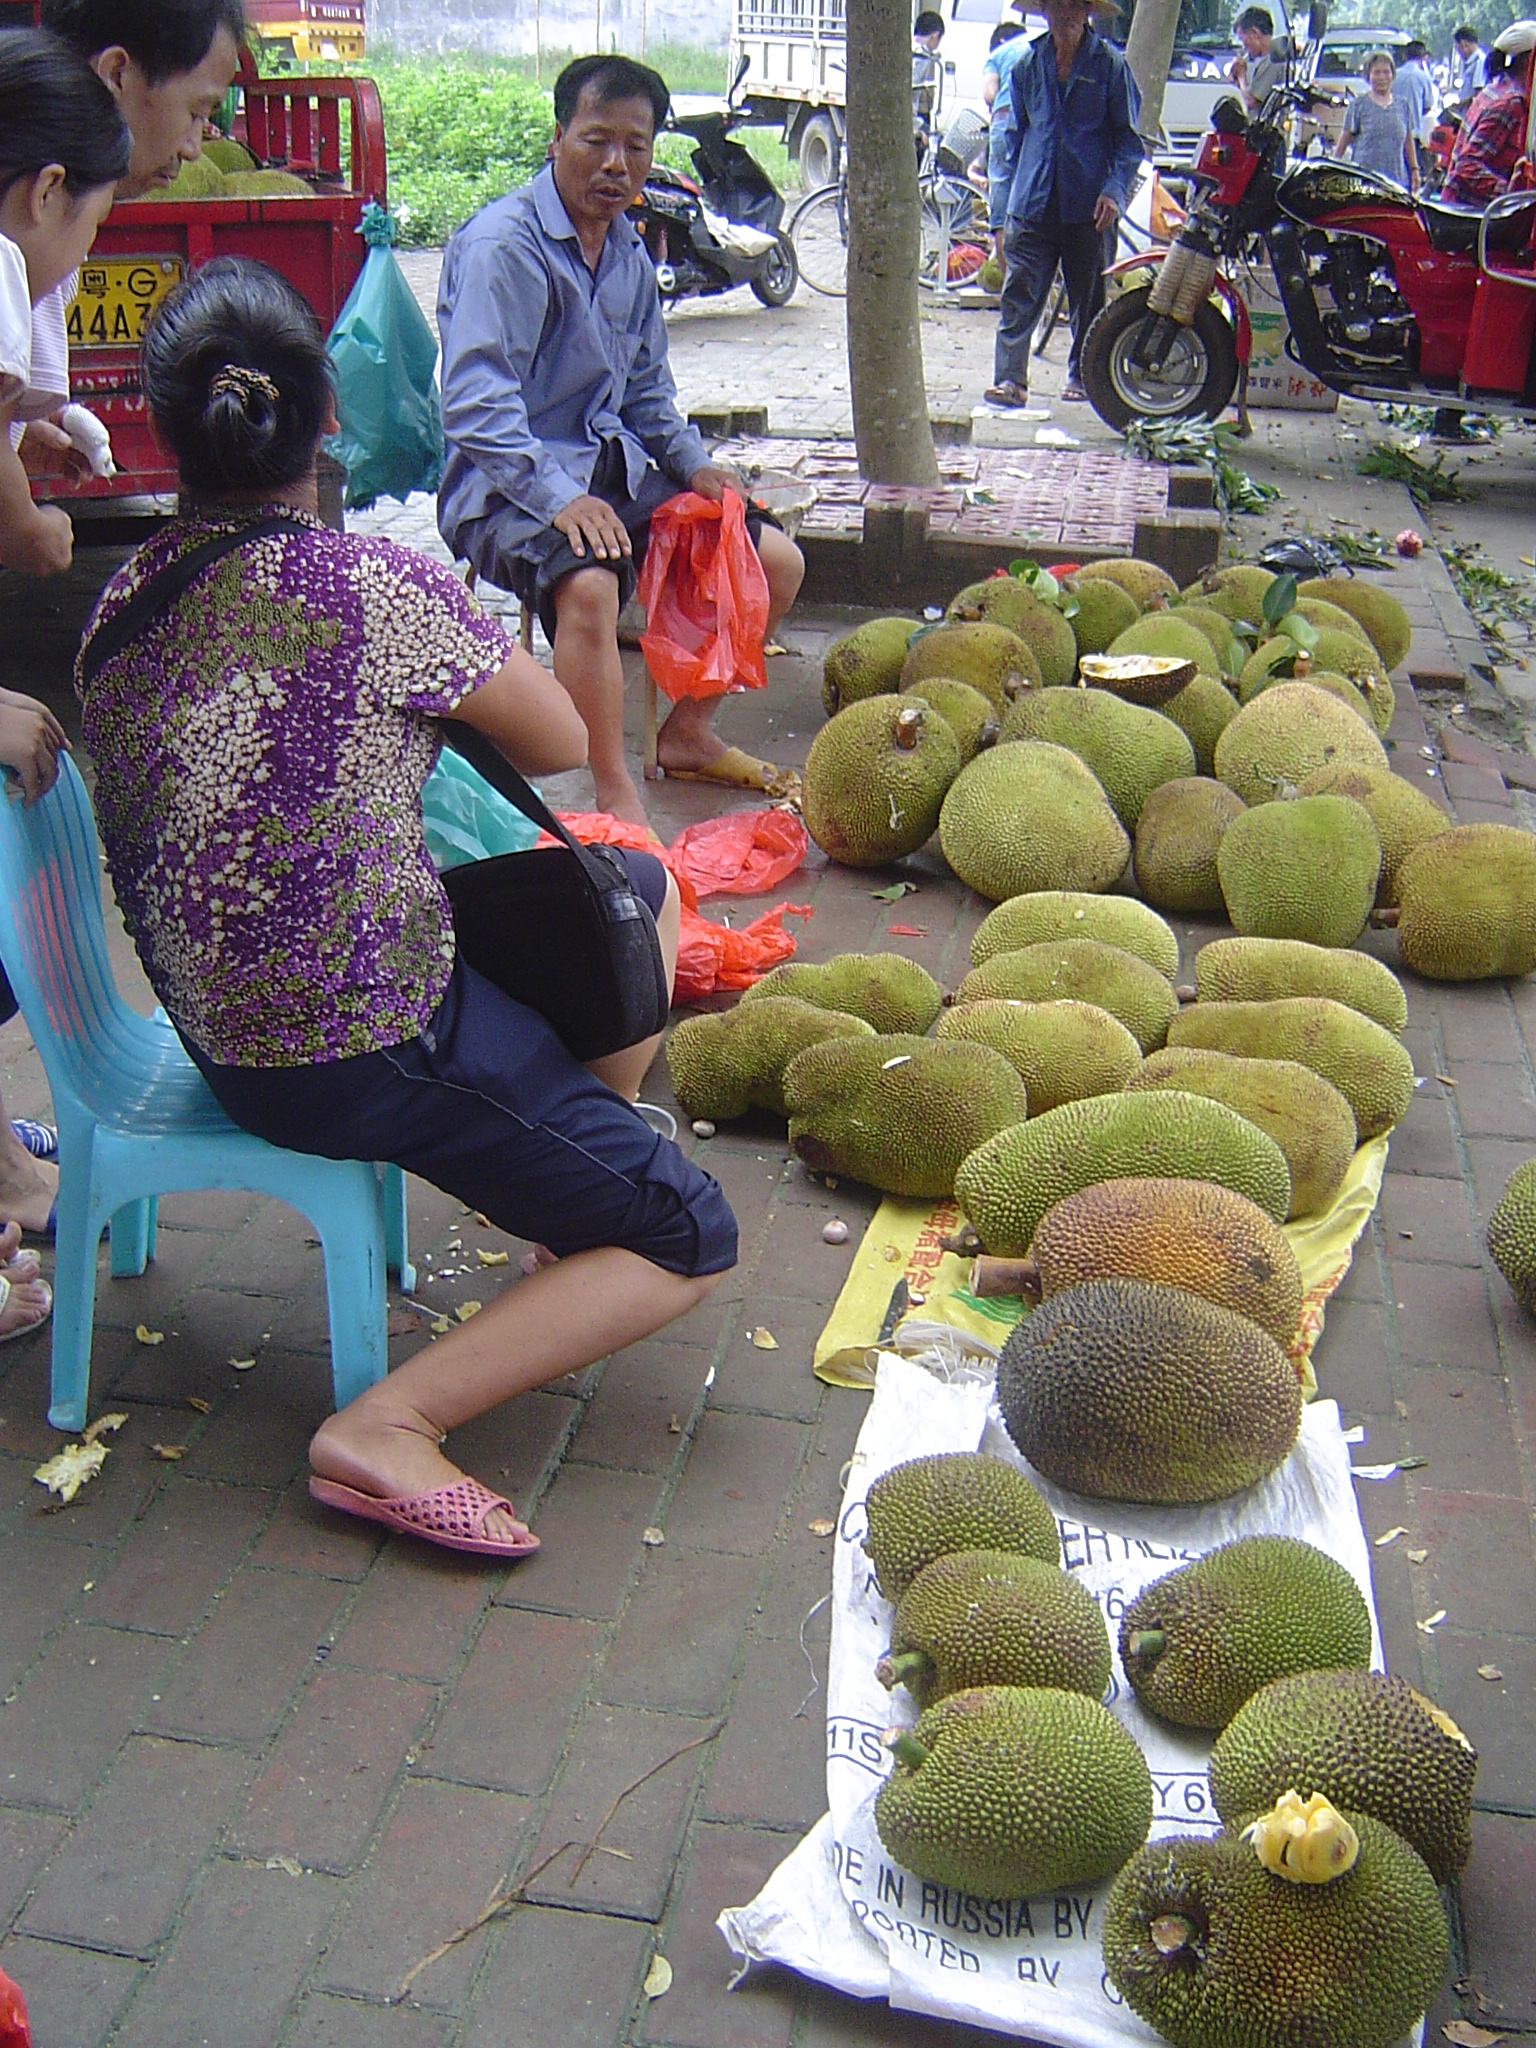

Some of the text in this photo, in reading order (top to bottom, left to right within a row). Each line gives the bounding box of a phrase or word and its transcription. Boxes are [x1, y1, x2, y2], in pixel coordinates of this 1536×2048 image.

[877, 1863, 904, 1909] IN
[920, 1880, 1036, 1939] RUSSIA
[1054, 1897, 1093, 1941] BY
